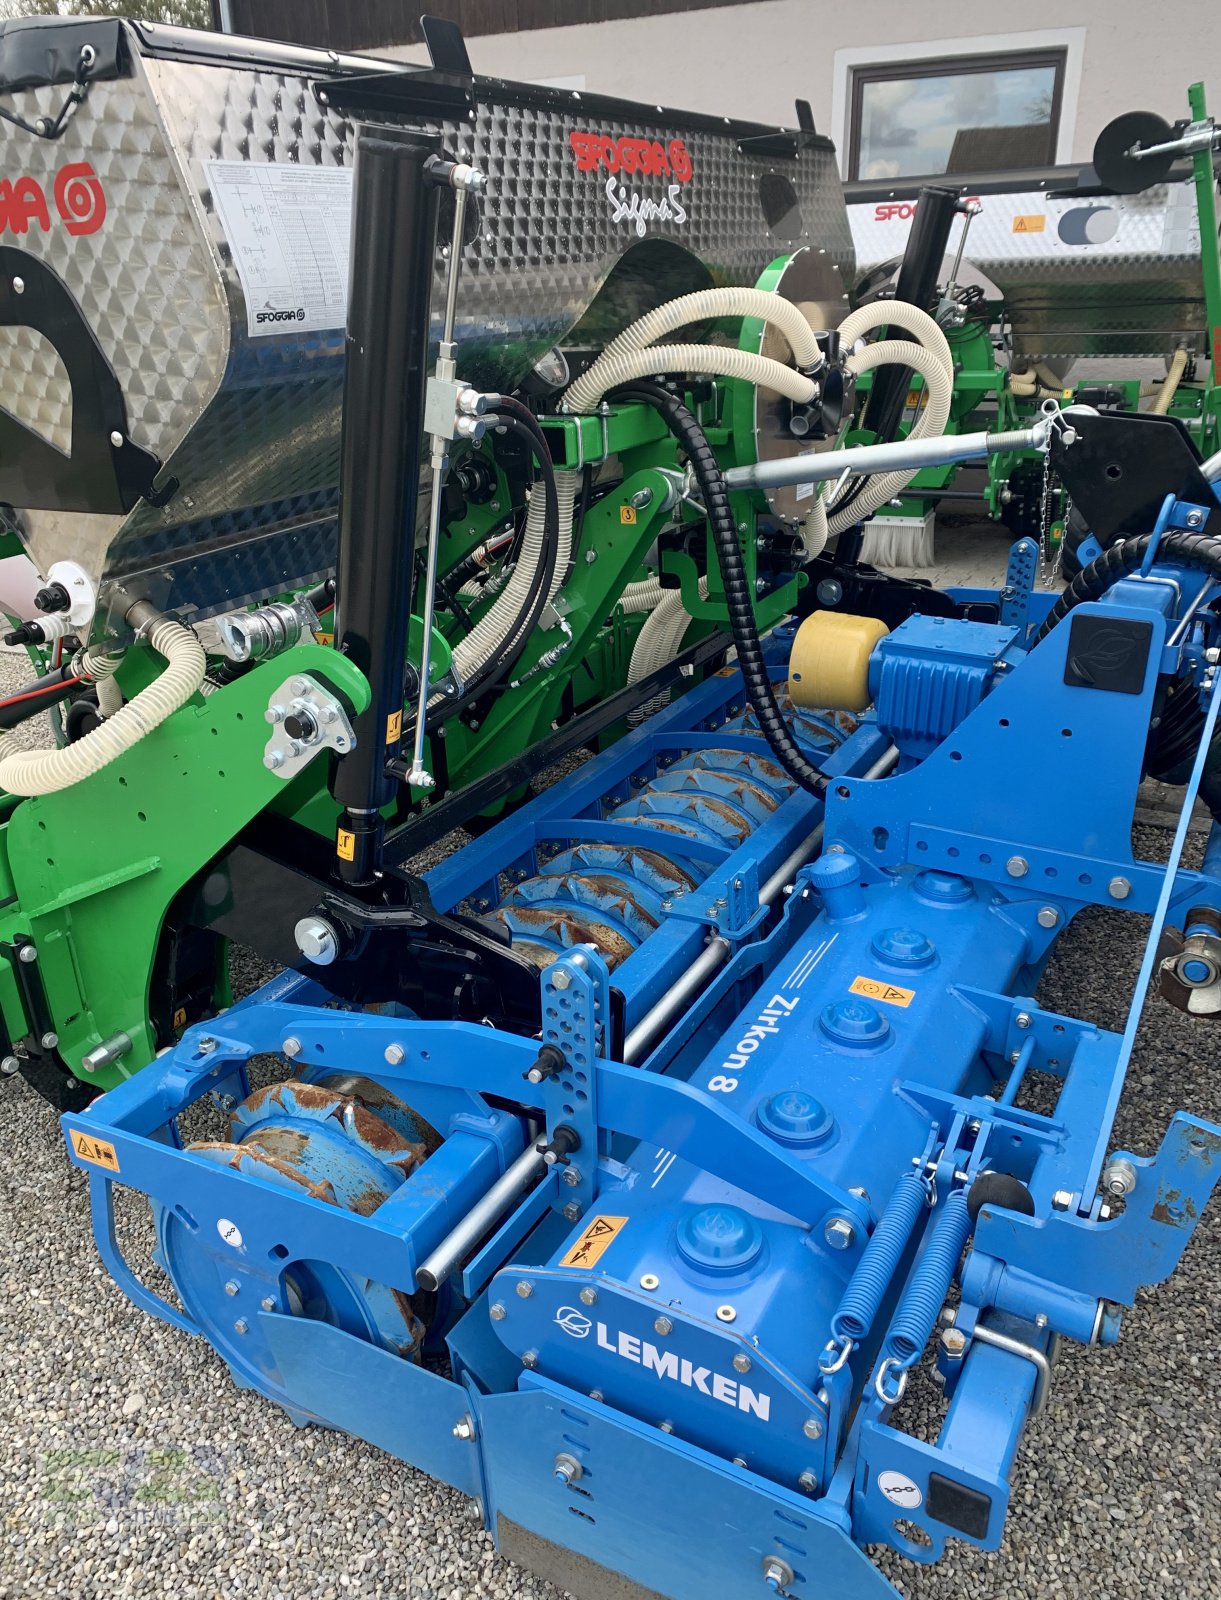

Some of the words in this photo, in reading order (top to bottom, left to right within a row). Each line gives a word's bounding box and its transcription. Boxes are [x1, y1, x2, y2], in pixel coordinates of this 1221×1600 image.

[570, 131, 671, 177] SFOGGIA
[606, 176, 673, 238] Sigma
[256, 310, 296, 323] SFOGGIA
[722, 994, 801, 1070] Zirkon
[707, 1075, 739, 1093] 8
[597, 1321, 771, 1422] LEMKEN
